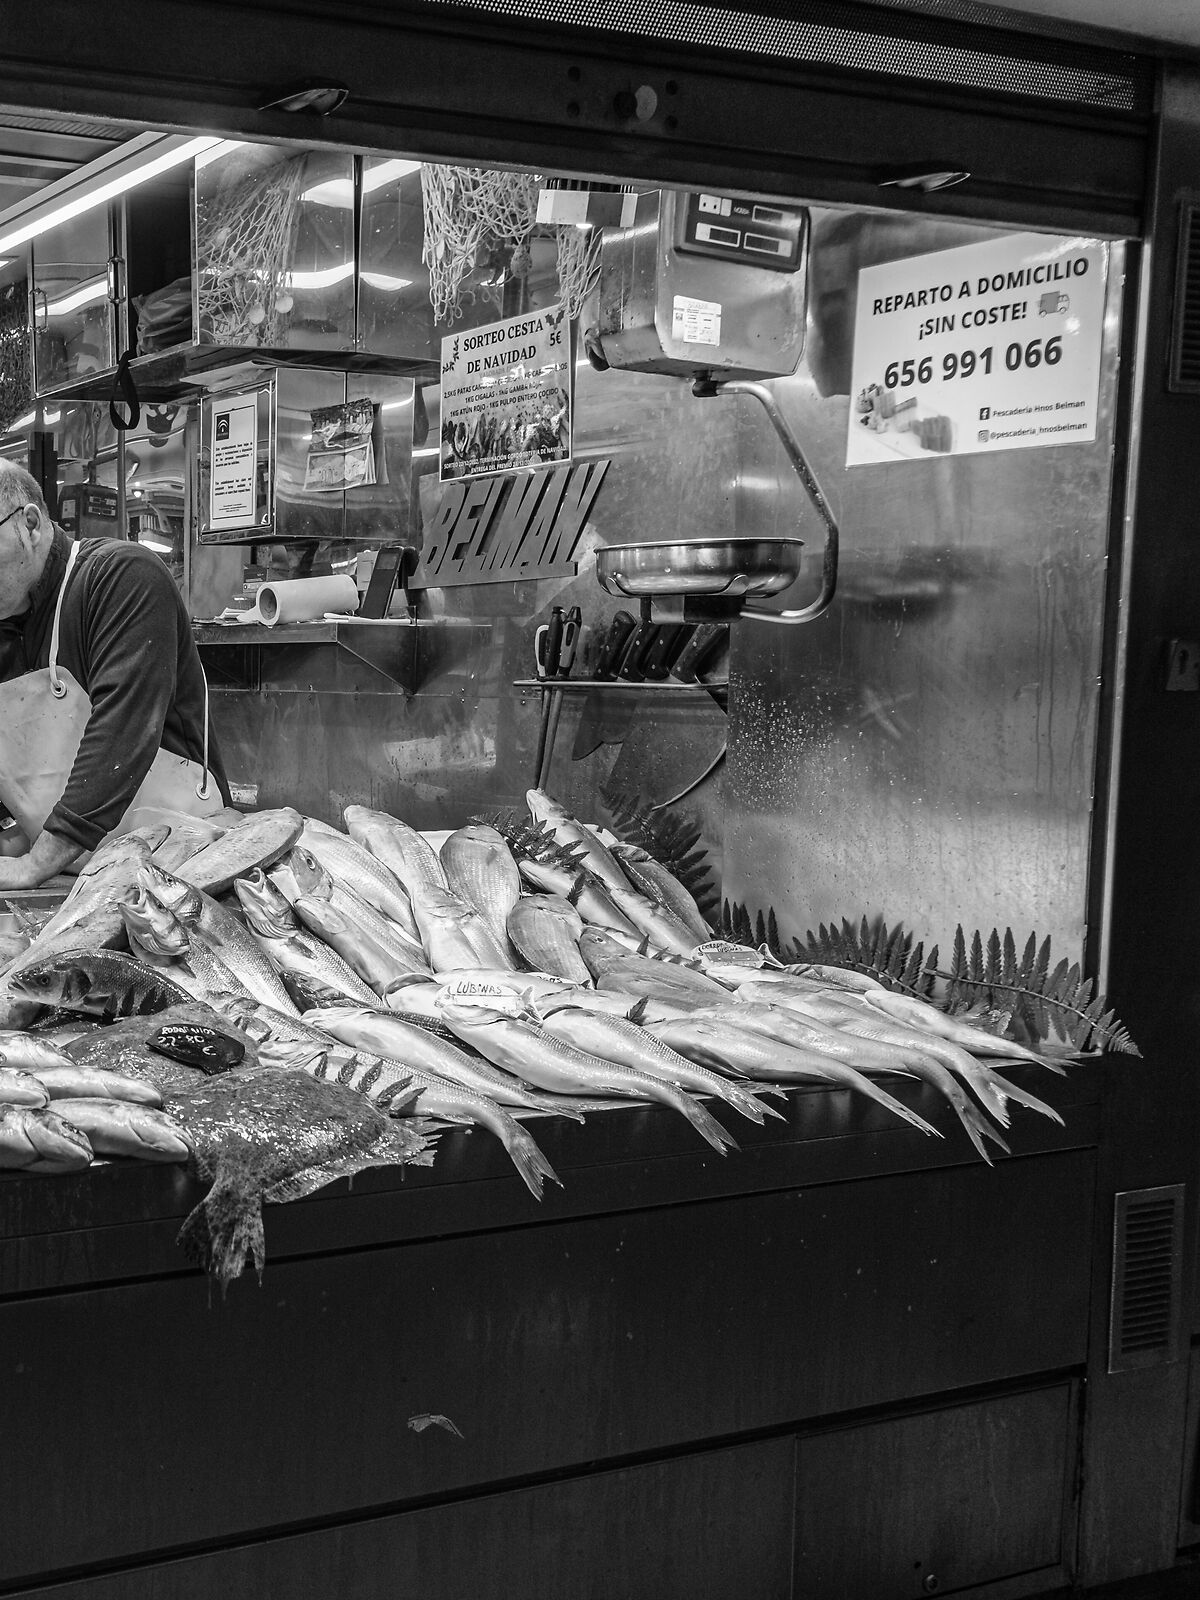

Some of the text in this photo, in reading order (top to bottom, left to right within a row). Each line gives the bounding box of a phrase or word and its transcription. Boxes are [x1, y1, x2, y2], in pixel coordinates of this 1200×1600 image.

[873, 257, 1089, 315] REPARTO A DOMICILIO
[919, 301, 1028, 340] ¡SIN COSTE!
[463, 318, 543, 352] SORTEO CESTA
[549, 330, 562, 346] 5€
[467, 359, 481, 374] DE
[483, 345, 536, 370] NAVIDAD
[884, 335, 1063, 389] 656 991 066
[457, 385, 472, 396] PATAS
[475, 390, 495, 402] CIGALAS
[539, 387, 559, 399] COCIDO
[1055, 400, 1086, 410] Belman
[414, 460, 611, 575] BELMAN
[456, 981, 502, 994] LUBINAS
